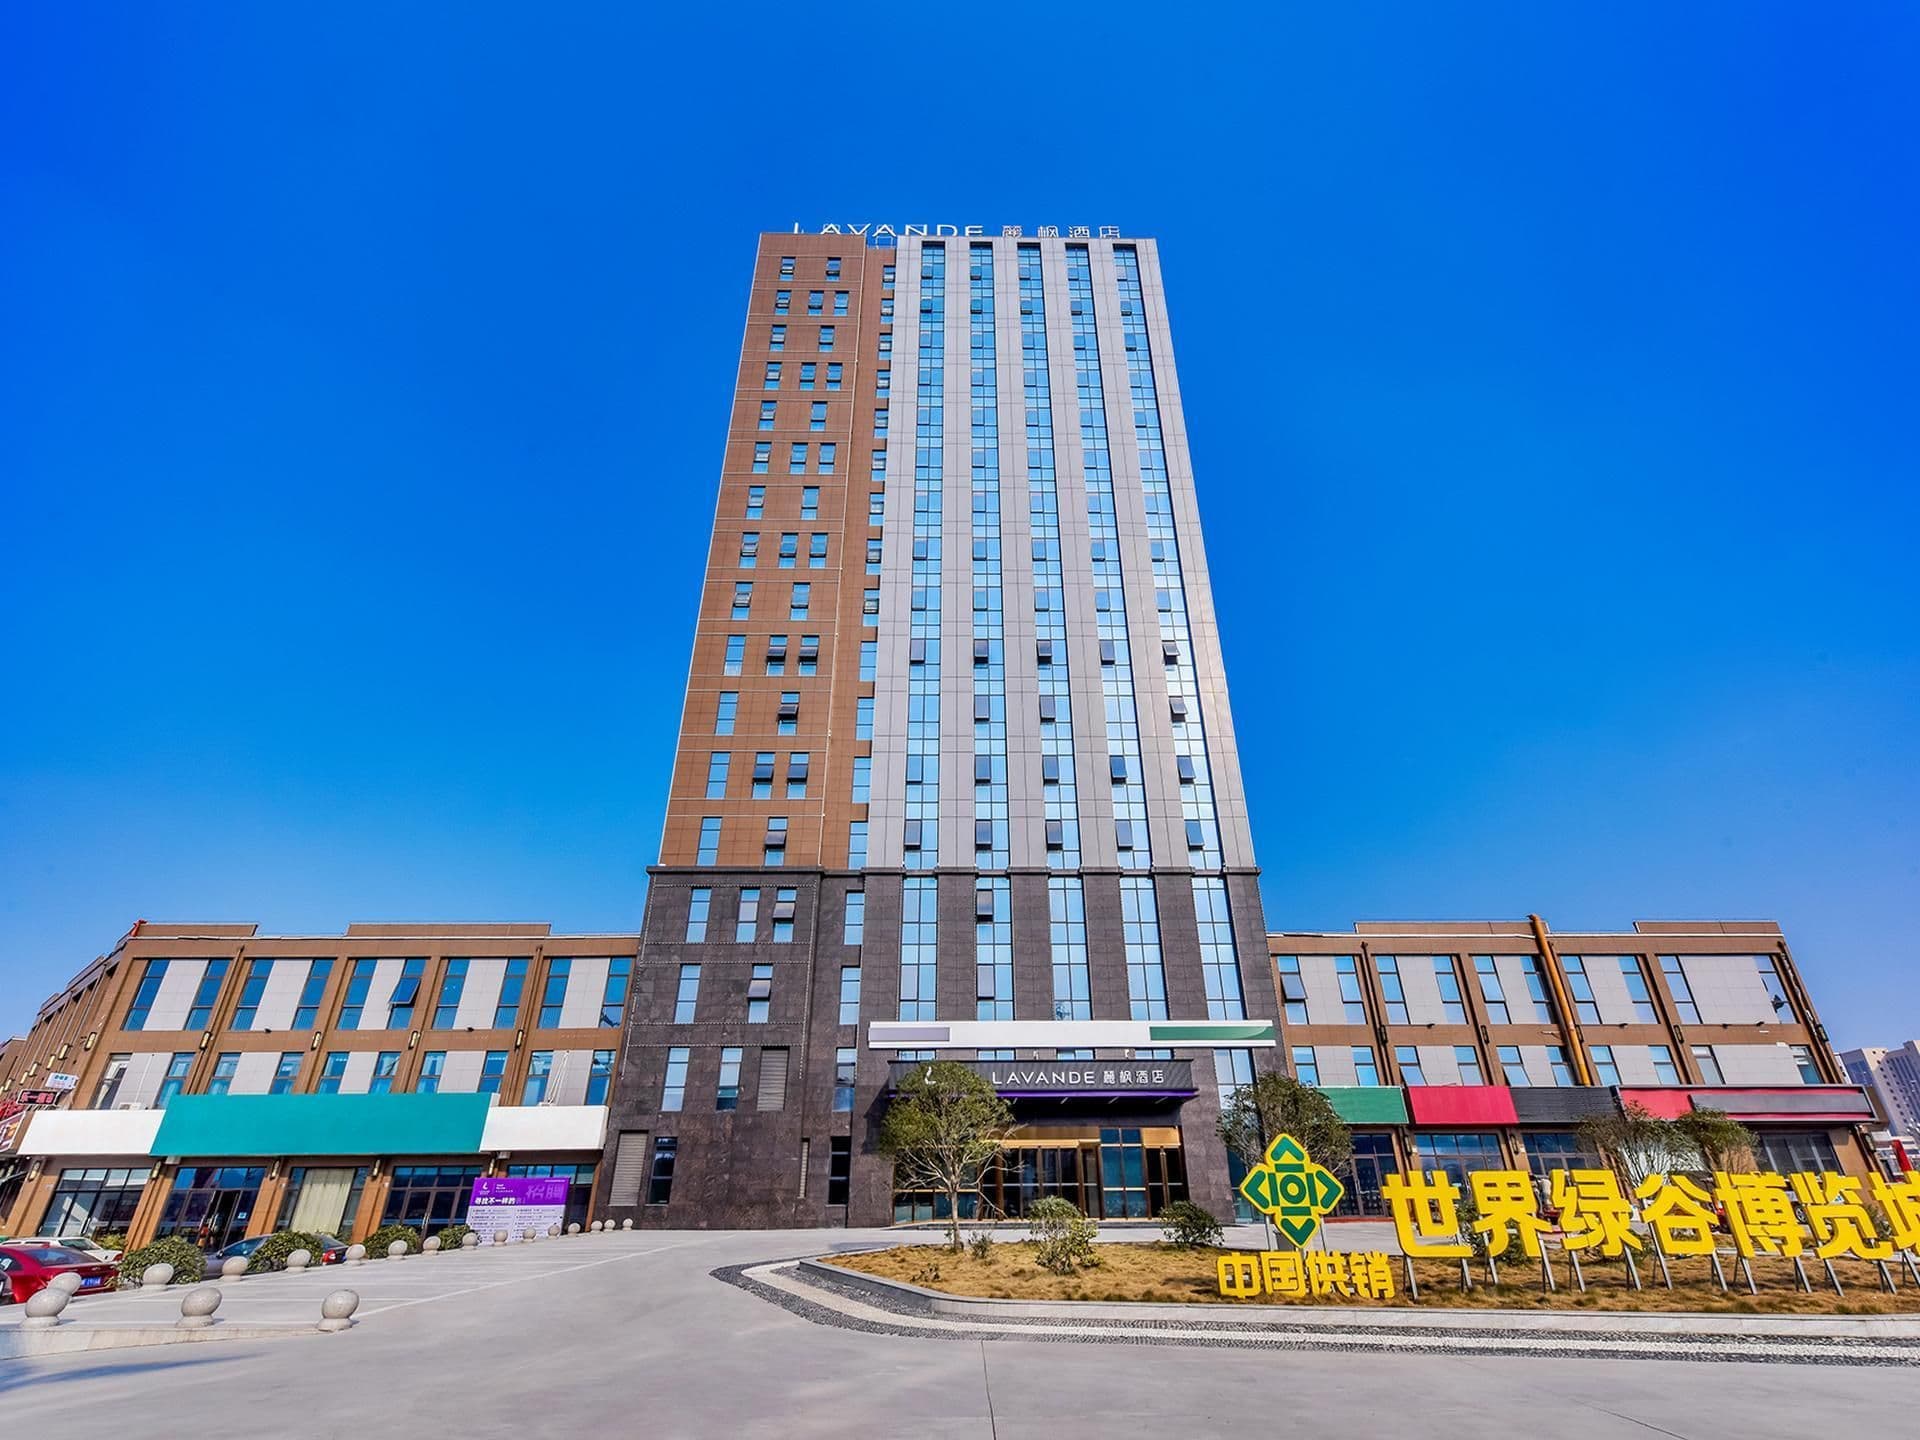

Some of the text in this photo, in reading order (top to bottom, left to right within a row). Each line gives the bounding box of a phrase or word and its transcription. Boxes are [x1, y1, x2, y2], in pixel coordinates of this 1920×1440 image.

[992, 1071, 1096, 1085] LAVANDE
[1217, 1250, 1396, 1299] 中国供销
